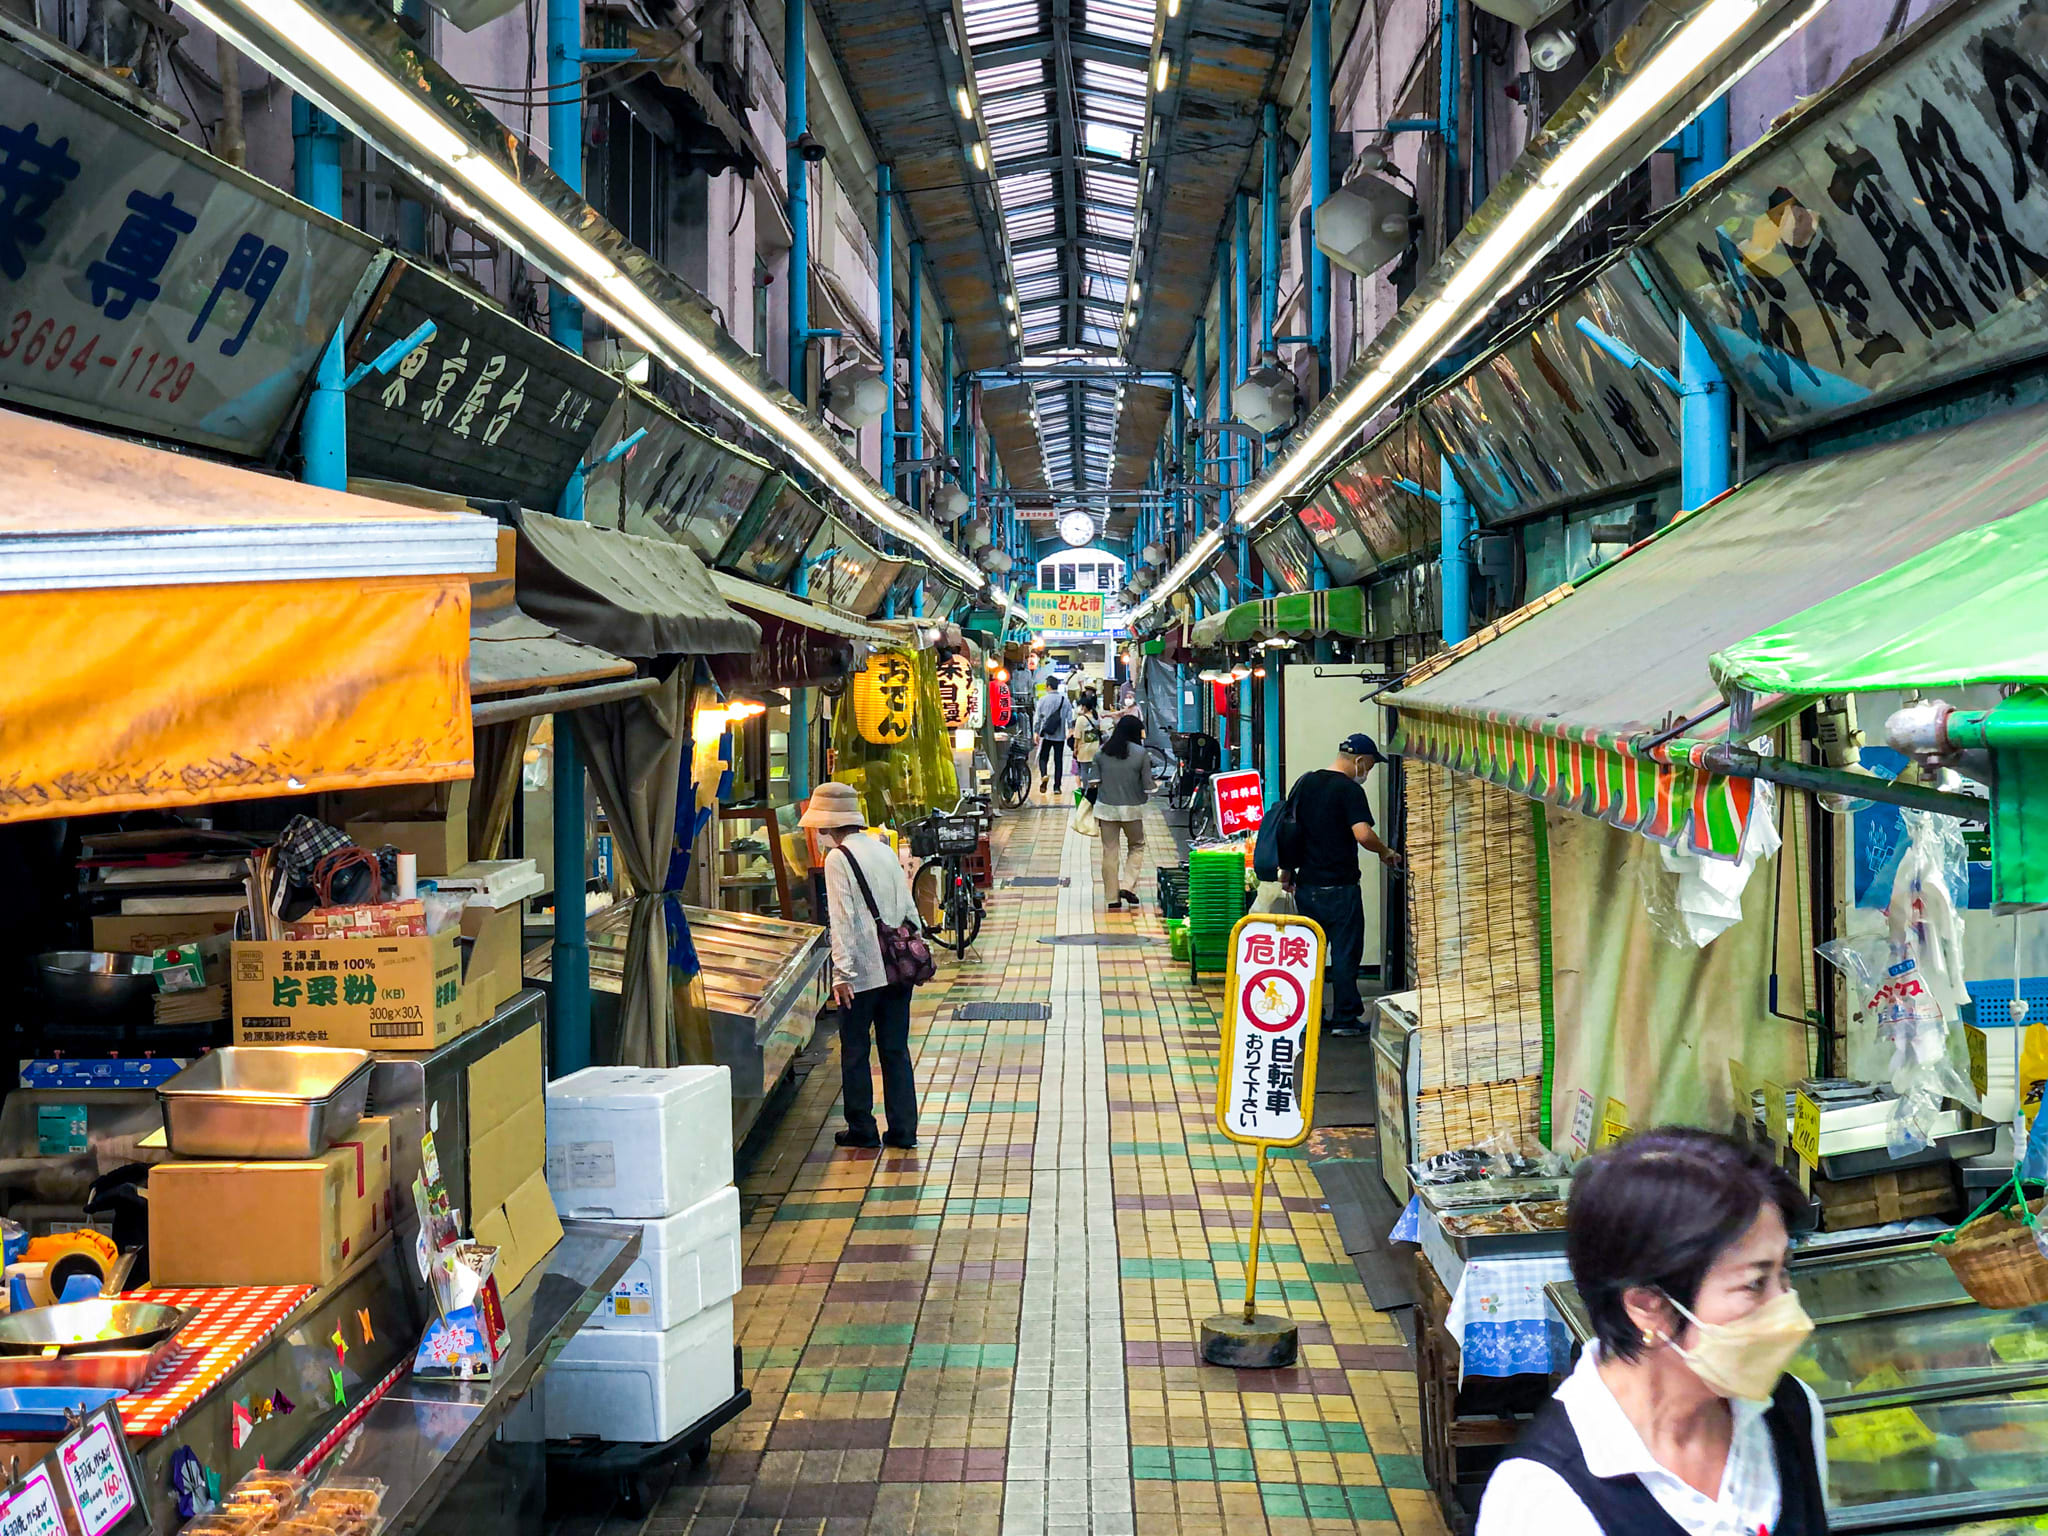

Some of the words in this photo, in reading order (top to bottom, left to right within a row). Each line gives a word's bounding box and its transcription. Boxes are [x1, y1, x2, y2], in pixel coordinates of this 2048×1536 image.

[0, 309, 196, 404] 3694-1129
[1058, 595, 1101, 612] どんと市
[878, 659, 911, 738] おでん
[282, 950, 321, 961] 北海道
[343, 958, 376, 970] 100%
[1244, 934, 1311, 968] 危険
[272, 973, 378, 1008] 片栗粉
[381, 988, 406, 1000] (KB)
[369, 1005, 423, 1021] 300g×30入
[1239, 1033, 1264, 1128] おりて下さい
[1265, 1035, 1294, 1117] 自転車
[103, 1473, 120, 1499] 160
